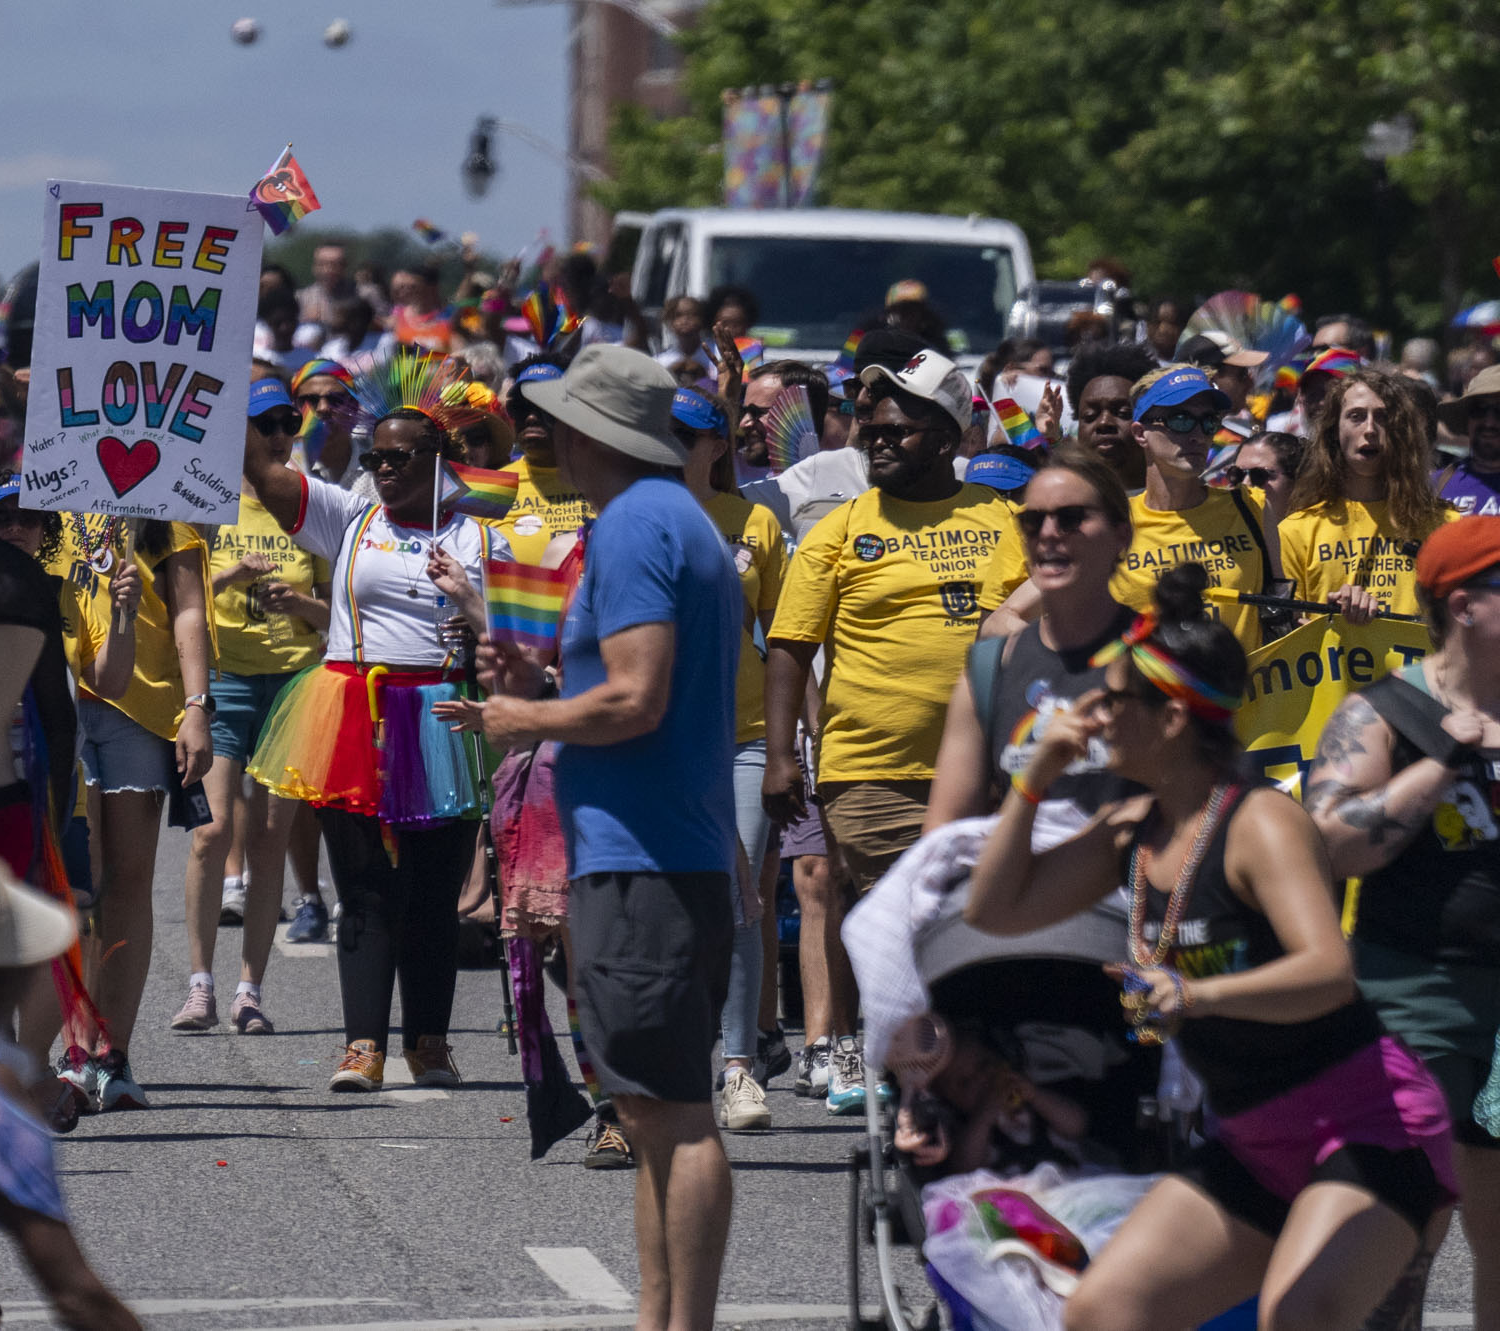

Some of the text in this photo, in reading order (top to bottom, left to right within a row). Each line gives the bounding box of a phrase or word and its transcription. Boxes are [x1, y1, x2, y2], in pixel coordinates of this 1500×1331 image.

[58, 203, 238, 274] FREE
[66, 280, 222, 352] MOM
[56, 361, 224, 444] LOVE
[78, 429, 99, 444] What
[105, 427, 114, 435] do
[122, 428, 135, 437] you
[24, 459, 78, 493] Hugs?
[184, 457, 241, 504] Scolding?
[511, 493, 586, 510] BALTIMO
[545, 514, 584, 523] UNION
[211, 532, 301, 551] BALTIMO
[857, 546, 882, 554] pride
[1319, 537, 1406, 561] BALTIMO
[230, 550, 296, 562] TEHERS
[911, 546, 989, 561] TEACHERS
[1127, 534, 1252, 571] BALTIMORE
[930, 559, 977, 573] UNION
[1152, 556, 1236, 581] TEERS
[1343, 558, 1413, 575] TEACHERS
[1354, 574, 1397, 587] UNION
[1250, 644, 1374, 702] more
